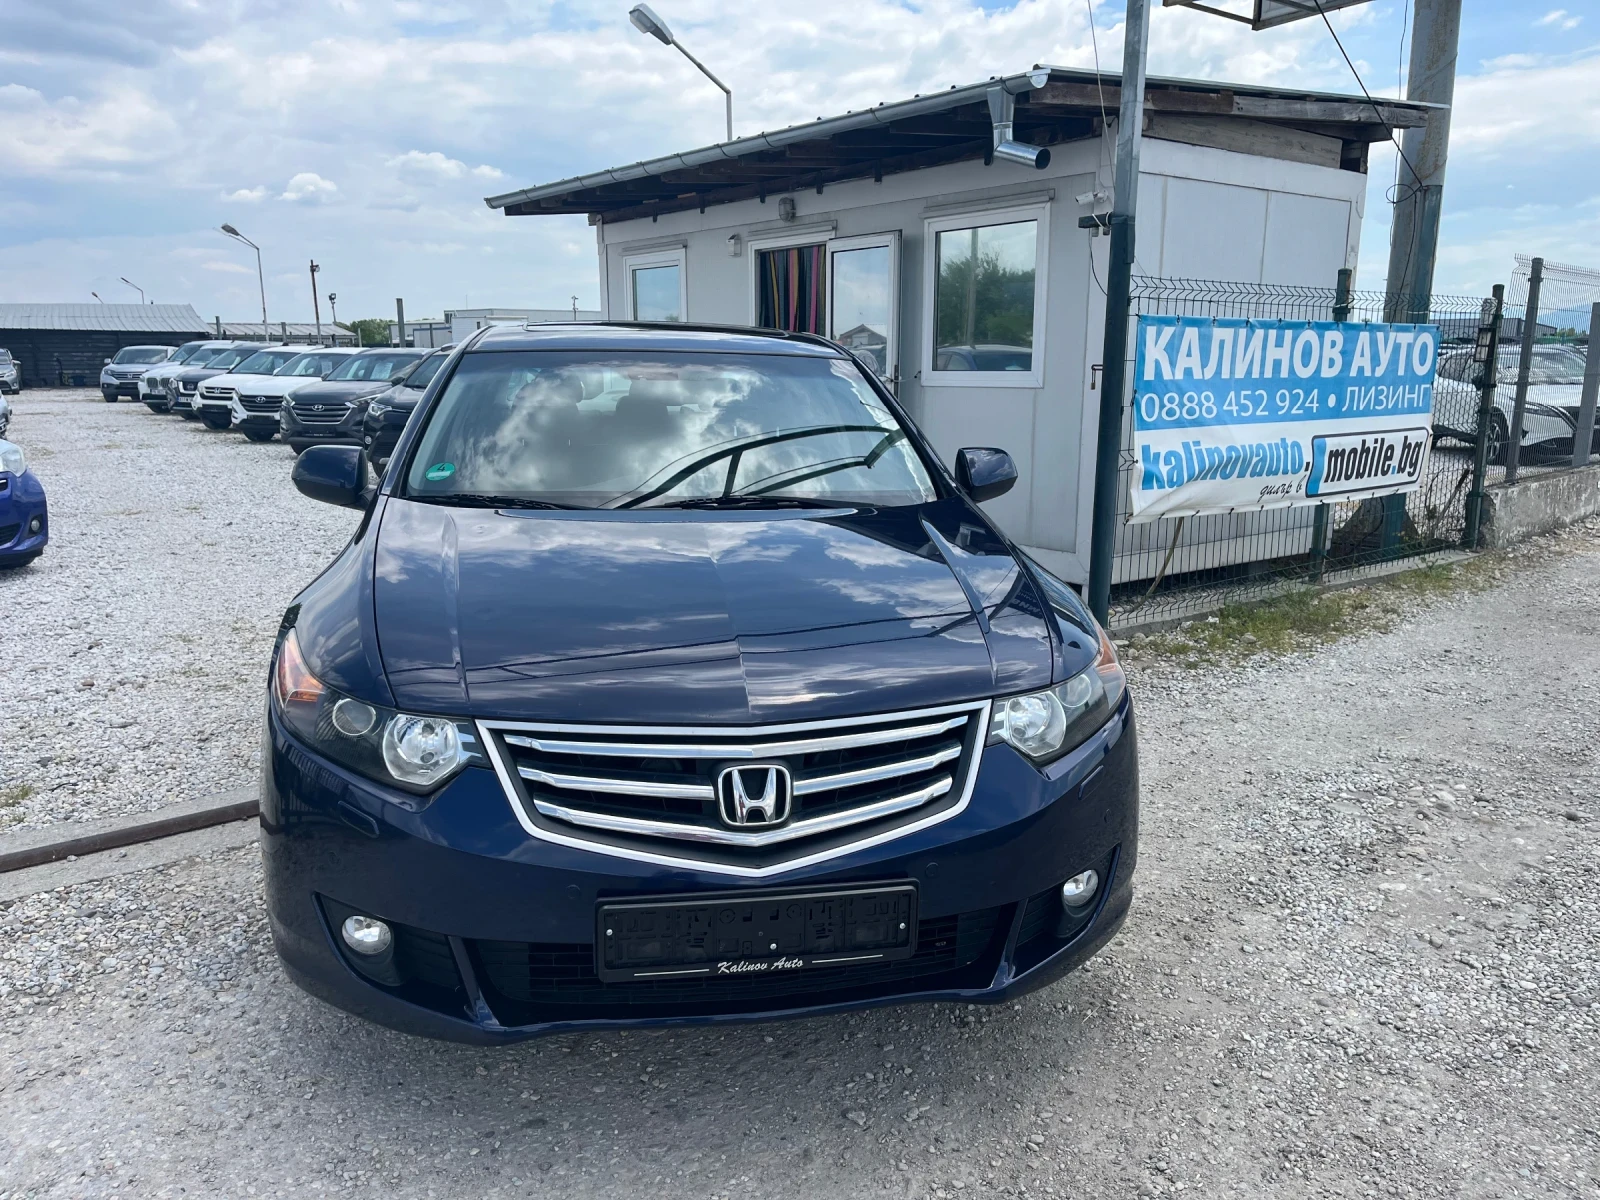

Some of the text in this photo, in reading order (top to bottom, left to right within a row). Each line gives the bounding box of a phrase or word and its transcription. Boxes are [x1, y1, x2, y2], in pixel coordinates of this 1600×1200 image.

[1143, 325, 1434, 381] КАЛИНОВ АУТО
[1141, 383, 1431, 422] 0888 452 924 ЛИЗИНГ
[1323, 435, 1423, 483] mobile.bg
[717, 957, 803, 974] Kalinov Auto
